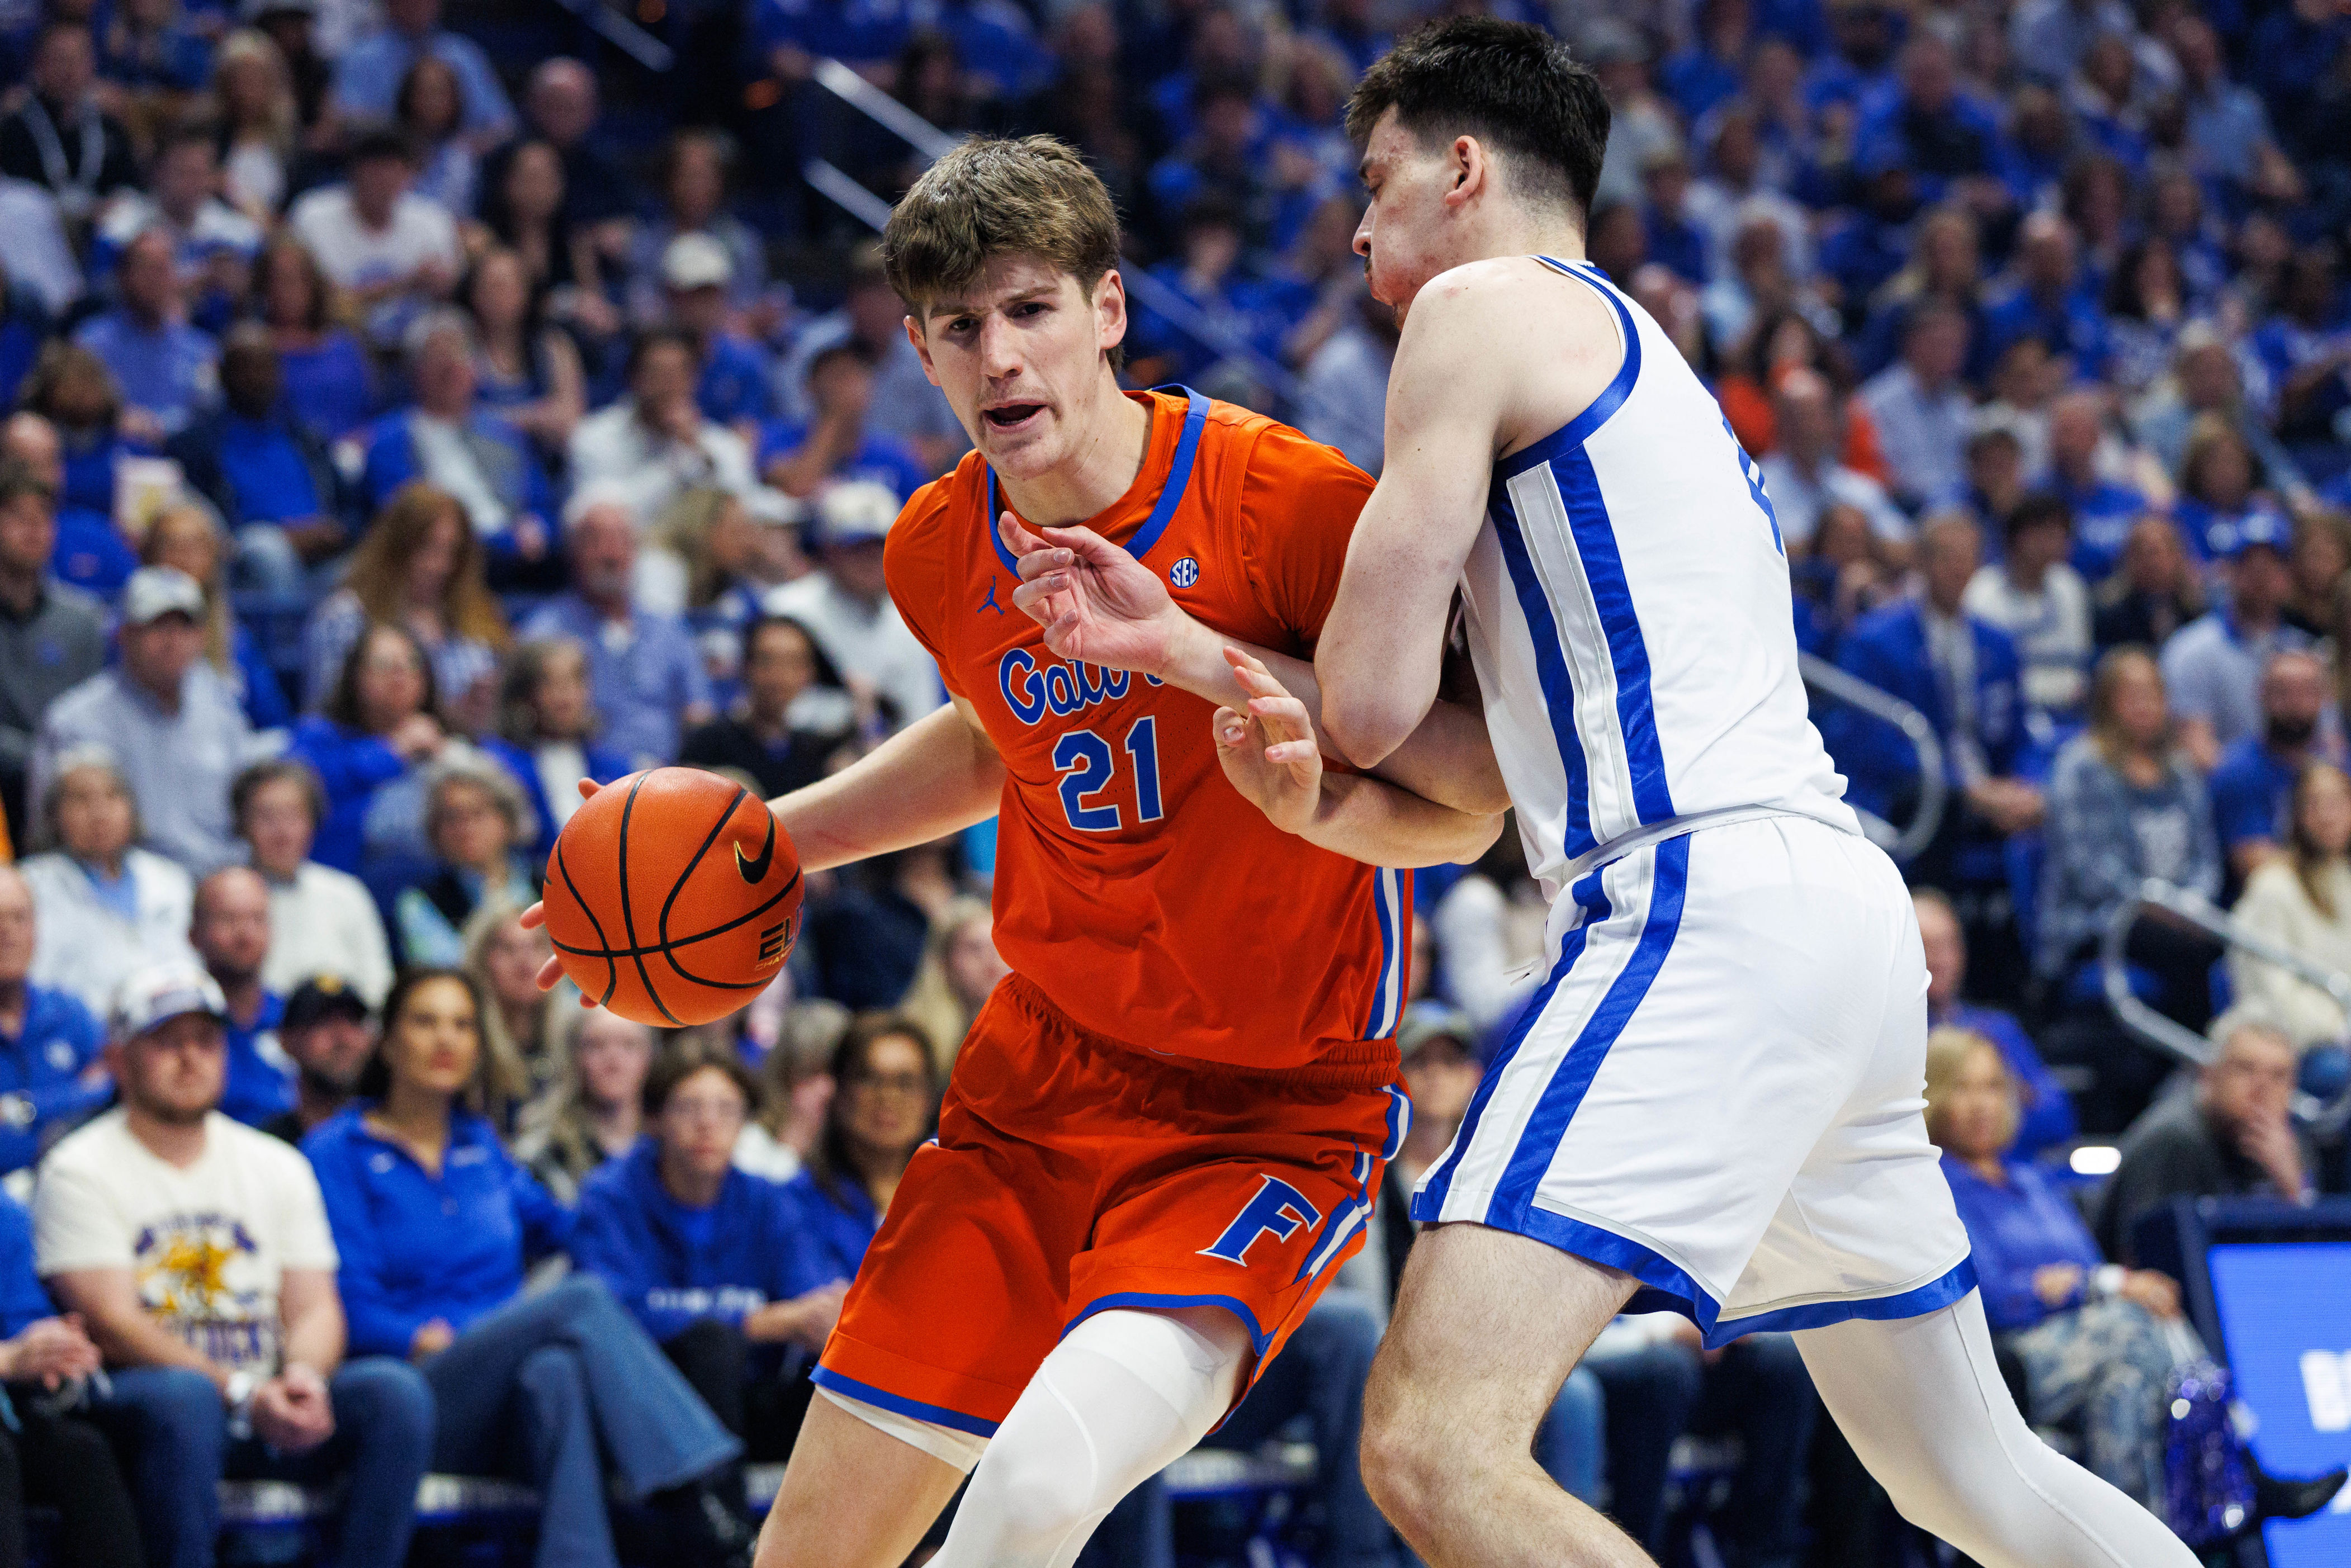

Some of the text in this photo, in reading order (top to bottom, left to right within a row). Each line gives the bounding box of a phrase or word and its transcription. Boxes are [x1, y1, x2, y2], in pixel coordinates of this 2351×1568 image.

[1170, 557, 1198, 587] SEC
[1052, 714, 1165, 832] 21
[1195, 1173, 1323, 1267] F
